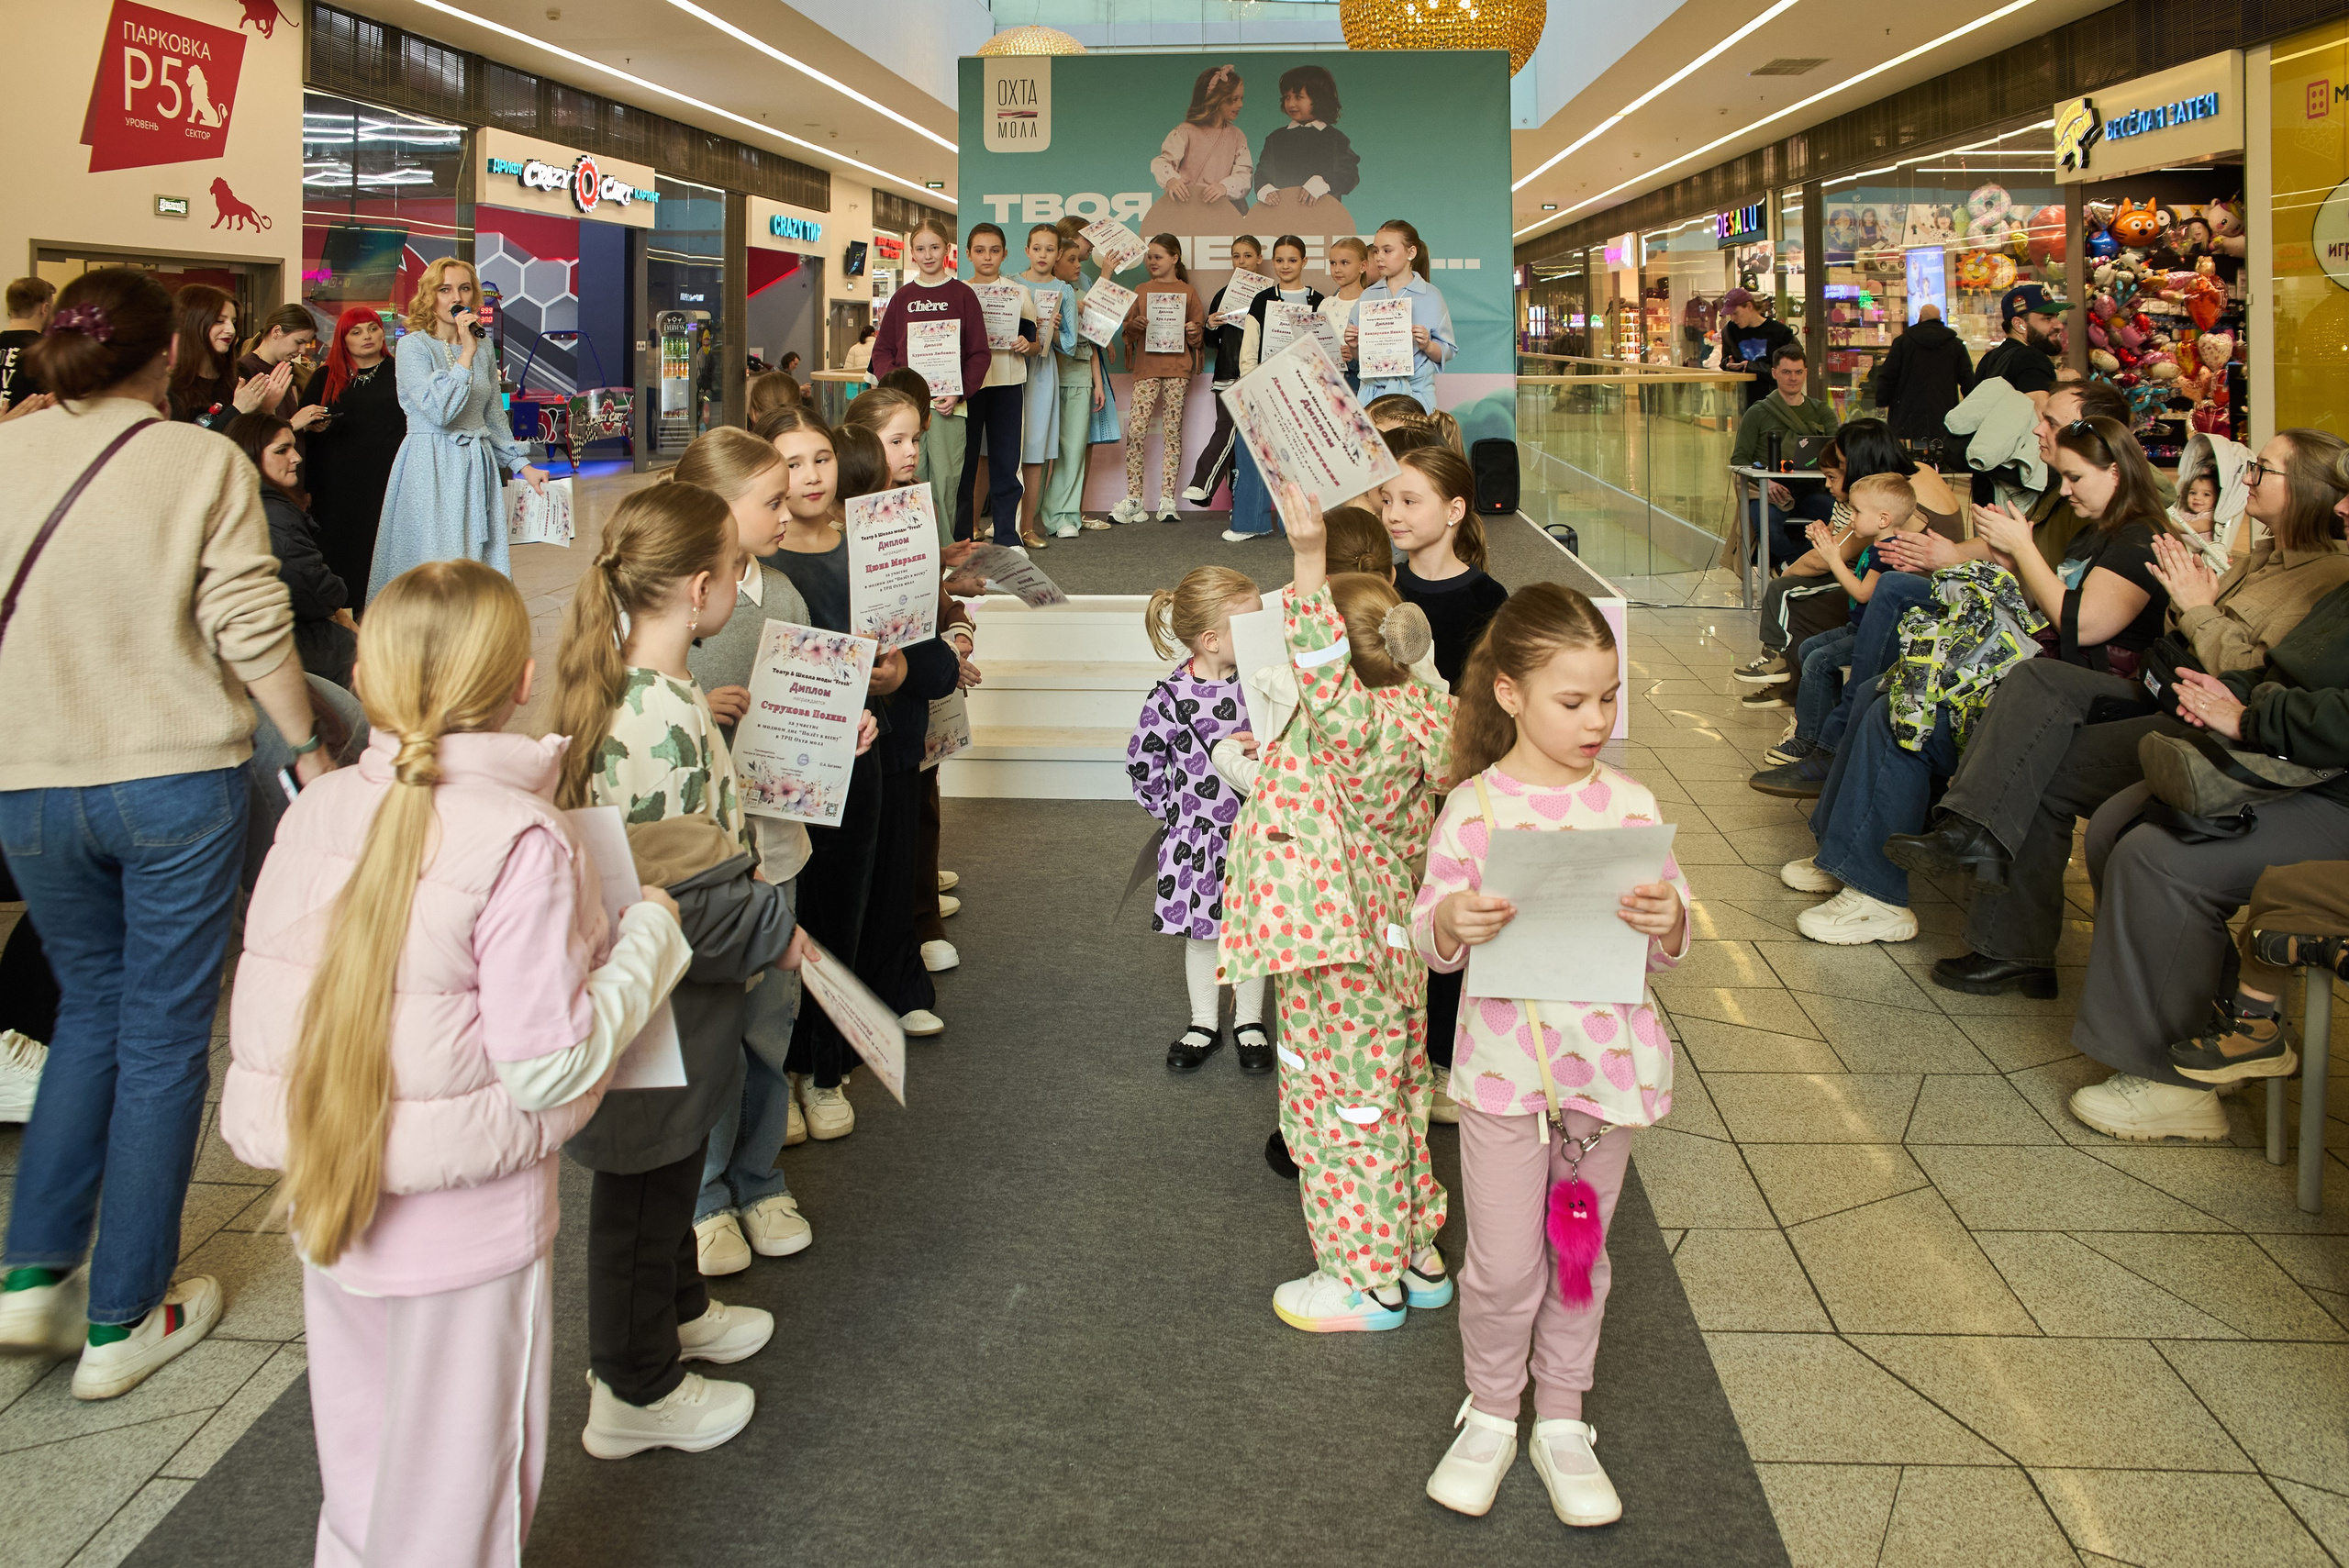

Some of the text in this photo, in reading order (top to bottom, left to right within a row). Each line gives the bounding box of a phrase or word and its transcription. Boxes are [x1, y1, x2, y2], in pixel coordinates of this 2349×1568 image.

[124, 20, 212, 61] ПАРКОВКА
[997, 79, 1038, 106] ОХТА
[125, 117, 160, 131] УРОВЕНЬ
[997, 120, 1038, 139] МОЛЛ
[2105, 92, 2219, 141] ВЕСЁЛАЯ ЗАТЕЯ
[184, 128, 211, 140] СЕКТОР
[492, 158, 661, 206] ДРИФТ CRAZY CART КАРТИНГ
[983, 192, 1152, 223] ТВОЯ
[773, 214, 822, 242] CRAZY ТИР
[1716, 204, 1757, 239] DESALU
[907, 299, 949, 313] Chère
[1296, 369, 1308, 389] Театр
[1311, 395, 1327, 420] Школа
[1326, 420, 1341, 440] моды
[1271, 376, 1340, 486] Данилова Анастасия
[1299, 399, 1334, 448] Диплом
[877, 537, 908, 551] Диплом
[890, 553, 926, 567] Марьяна
[772, 667, 789, 676] Театр
[795, 672, 815, 680] Школа
[789, 682, 830, 696] Диплом
[761, 700, 846, 722] Струкова Полина
